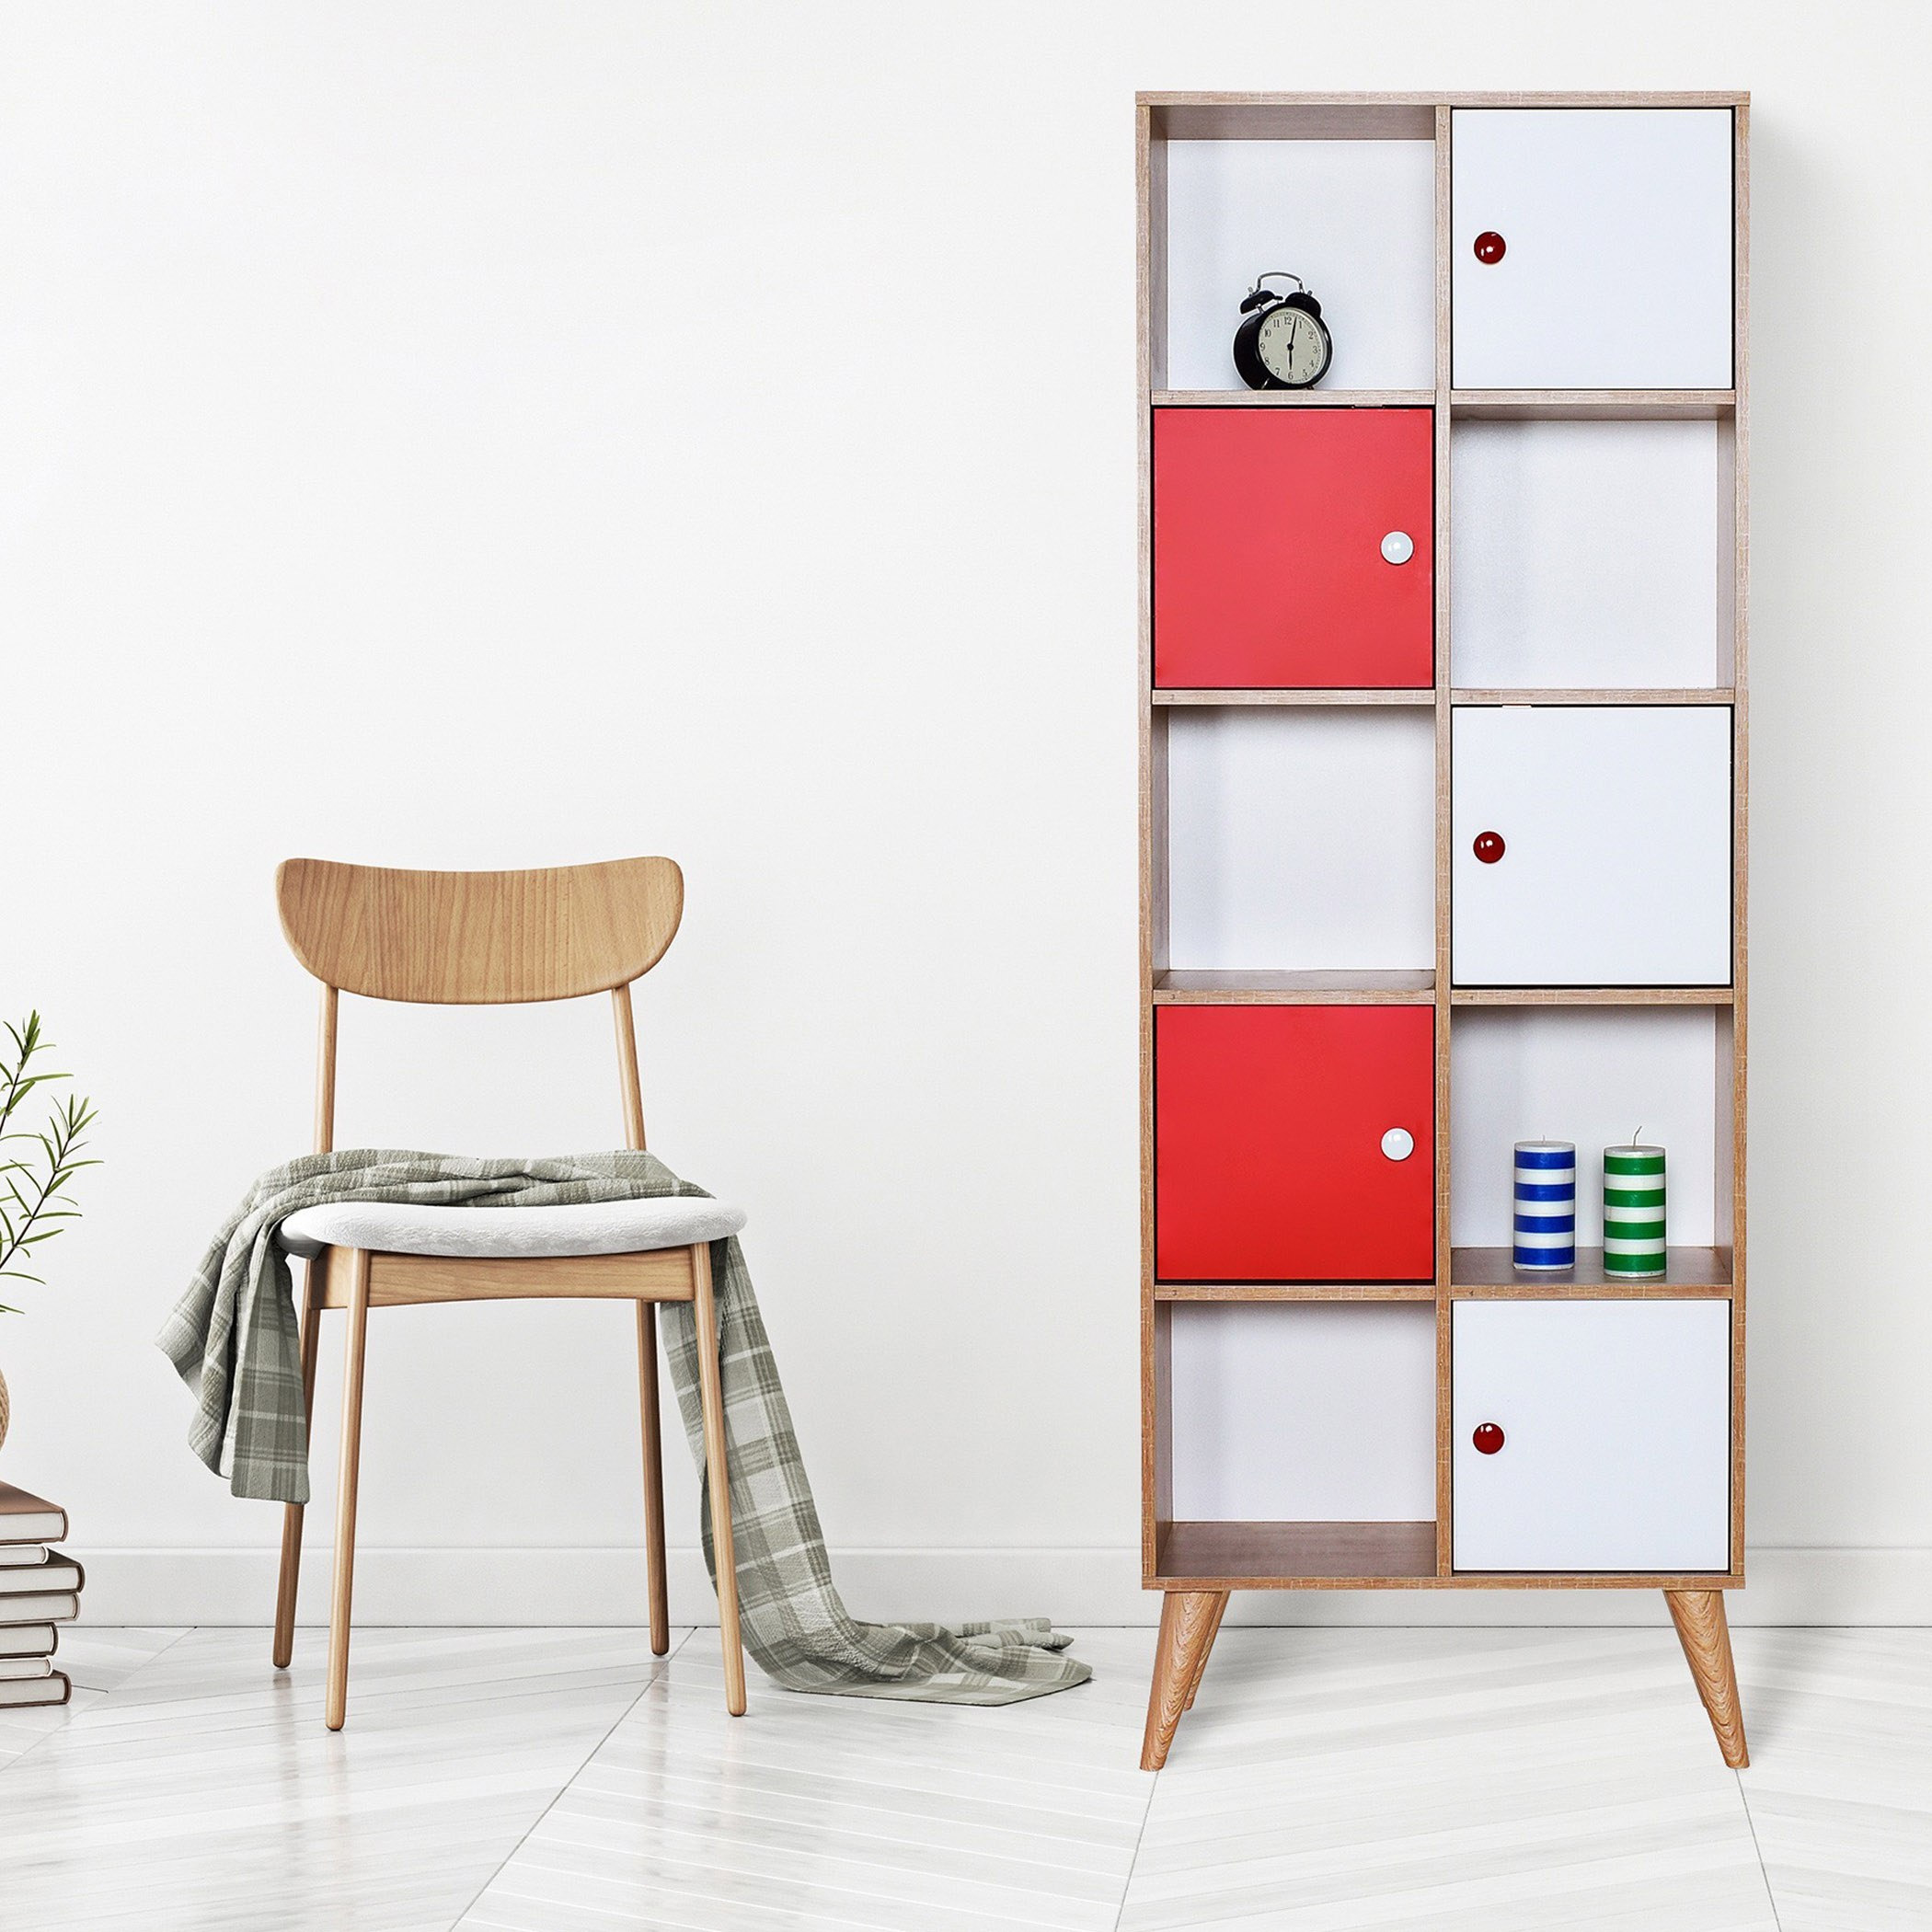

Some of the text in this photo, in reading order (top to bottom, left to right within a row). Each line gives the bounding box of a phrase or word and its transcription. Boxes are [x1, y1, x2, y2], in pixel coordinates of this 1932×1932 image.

[1273, 319, 1280, 328] 11
[1284, 316, 1292, 325] 12
[1299, 320, 1303, 328] 1
[1264, 328, 1271, 338] 10
[1308, 331, 1314, 339] 2
[1259, 342, 1265, 351] 9
[1312, 345, 1317, 353] 3
[1265, 357, 1270, 365] 8
[1275, 367, 1280, 375] 7
[1288, 372, 1294, 380] 6
